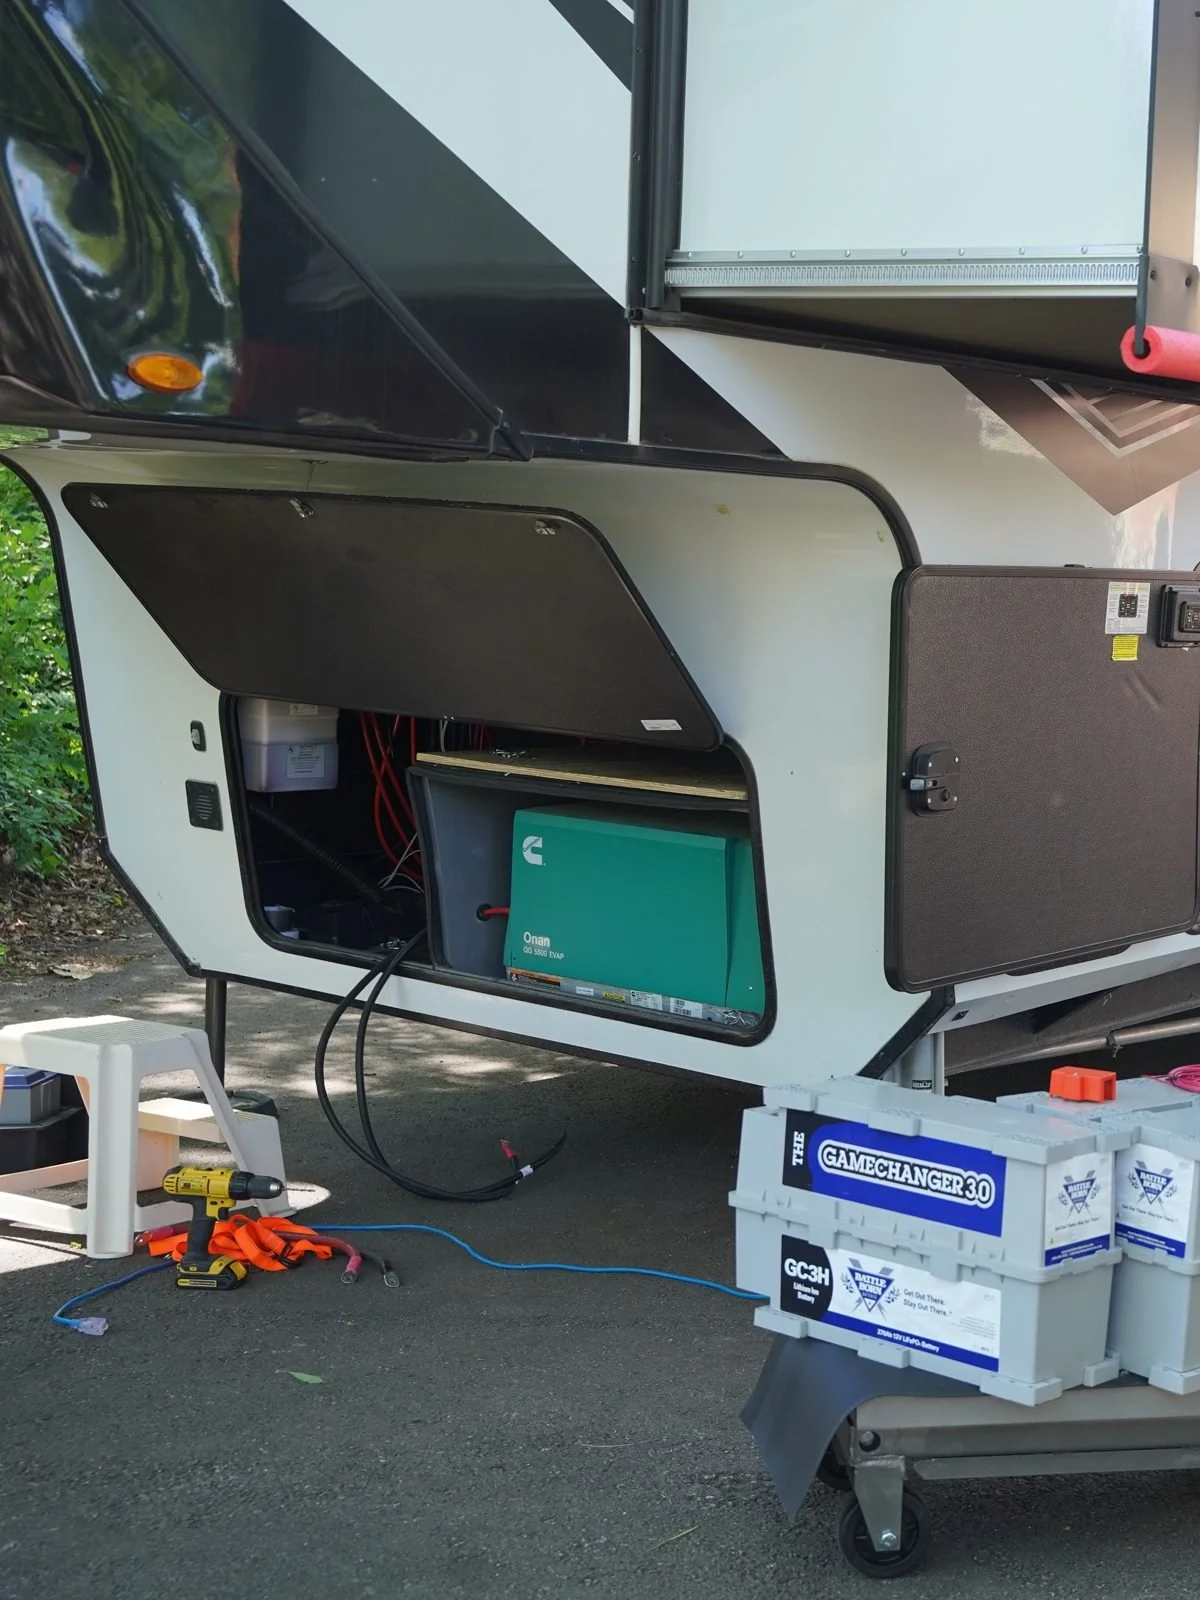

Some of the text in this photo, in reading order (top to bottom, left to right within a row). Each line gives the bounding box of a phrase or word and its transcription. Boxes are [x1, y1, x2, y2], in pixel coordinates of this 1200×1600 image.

[523, 931, 551, 947] Onan
[549, 950, 565, 960] EVAP
[791, 1131, 805, 1166] THE
[822, 1146, 964, 1196] GAMECHANGER
[784, 1258, 830, 1286] GC3H
[854, 1271, 887, 1288] BATTLE
[858, 1282, 883, 1295] BORN
[903, 1288, 914, 1298] Get
[915, 1291, 926, 1301] Out
[903, 1299, 917, 1309] Stay
[918, 1302, 928, 1312] Out
